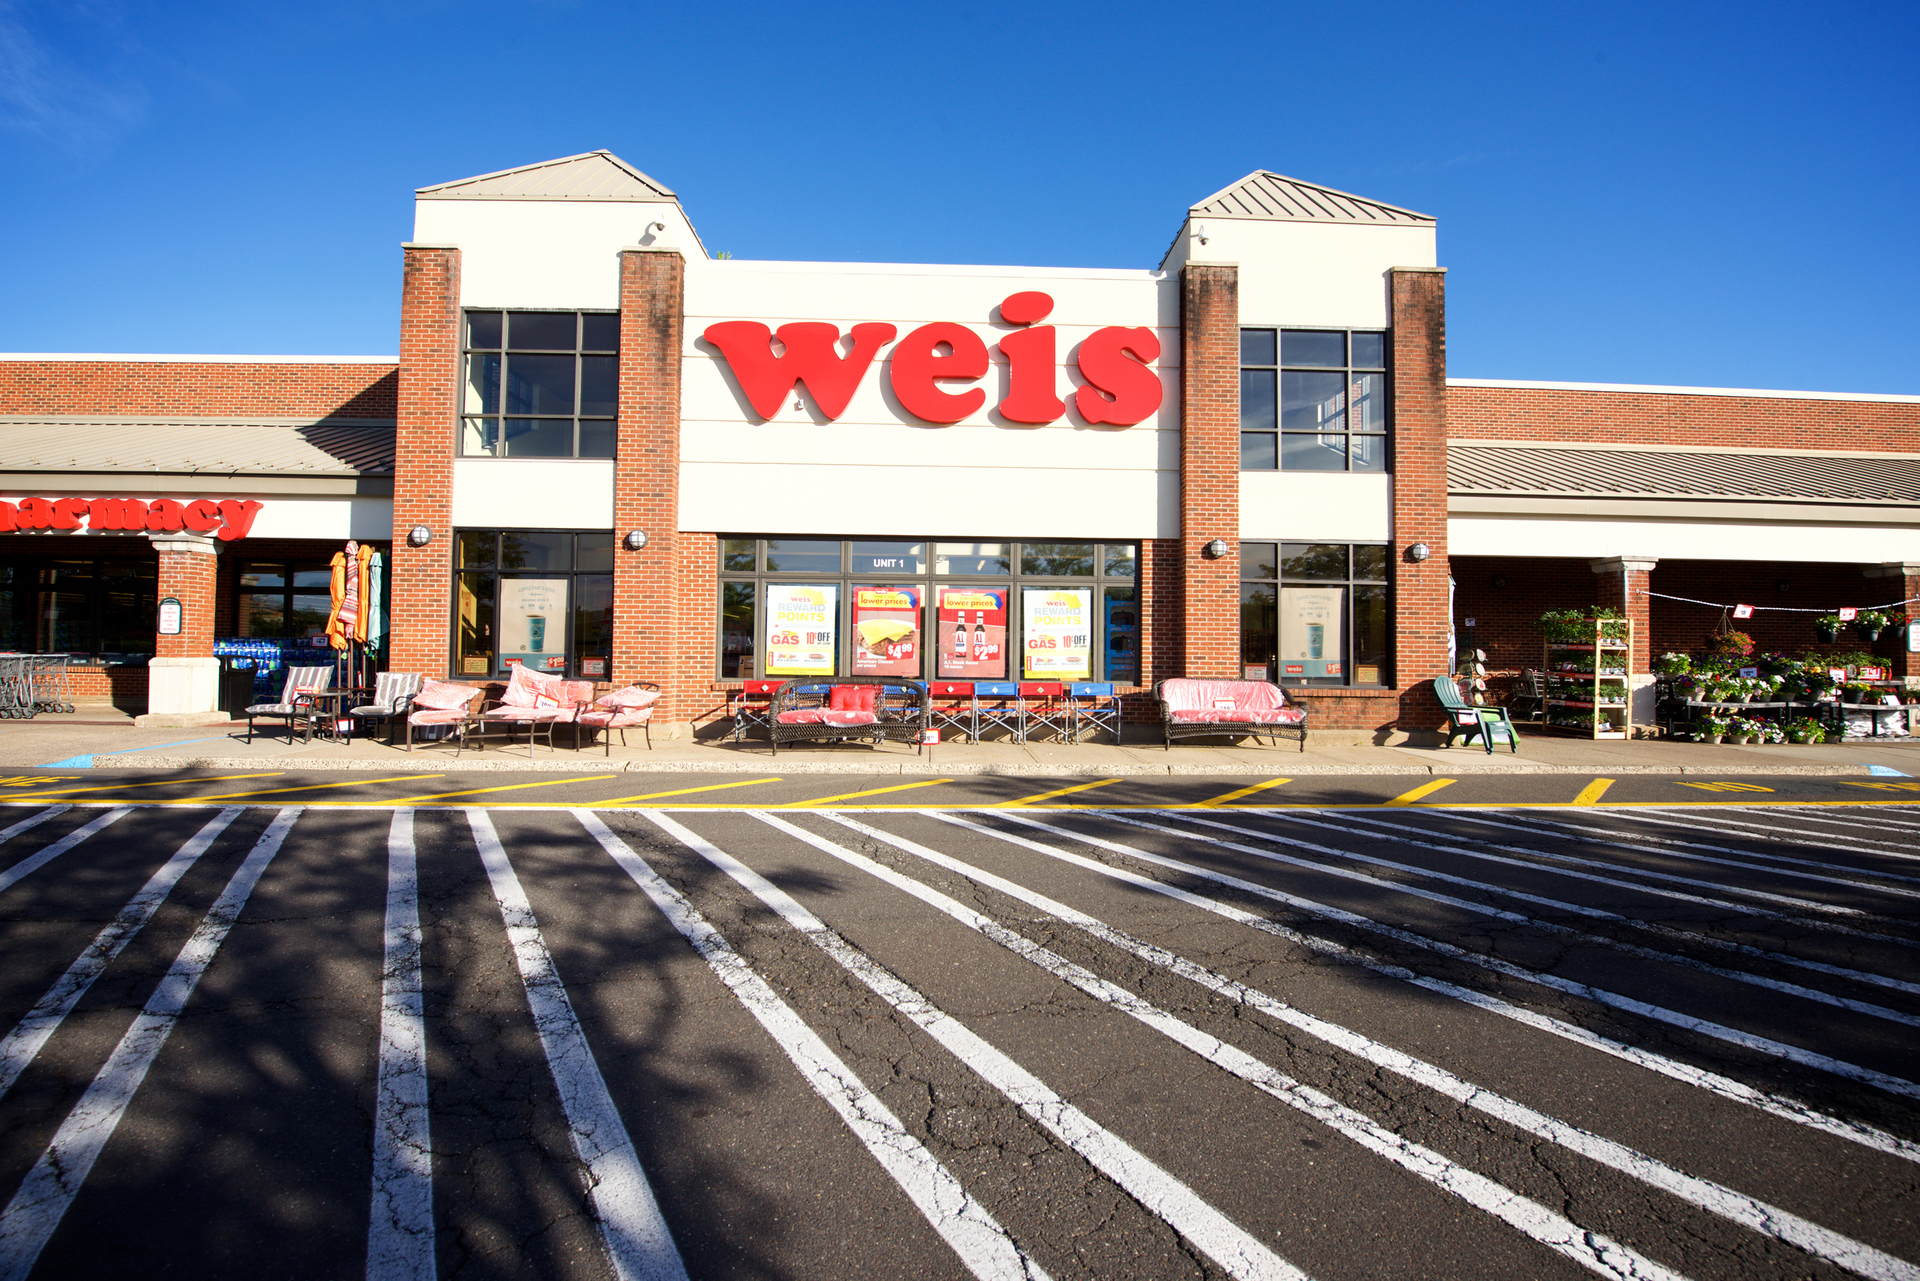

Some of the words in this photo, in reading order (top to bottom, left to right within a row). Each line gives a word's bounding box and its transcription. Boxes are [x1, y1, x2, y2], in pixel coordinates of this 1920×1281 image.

[703, 291, 1162, 426] weis
[873, 558, 897, 568] UNIT
[898, 559, 904, 568] 1
[860, 594, 883, 604] lower
[885, 598, 908, 606] prices
[947, 595, 969, 606] lower
[971, 600, 994, 608] prices
[778, 603, 826, 612] REWARD
[778, 612, 825, 622] POINTS
[1035, 616, 1081, 625] POINTS
[771, 635, 800, 645] GAS
[817, 632, 830, 641] OFF
[1074, 635, 1087, 644] OFF
[1028, 639, 1057, 649] GAS
